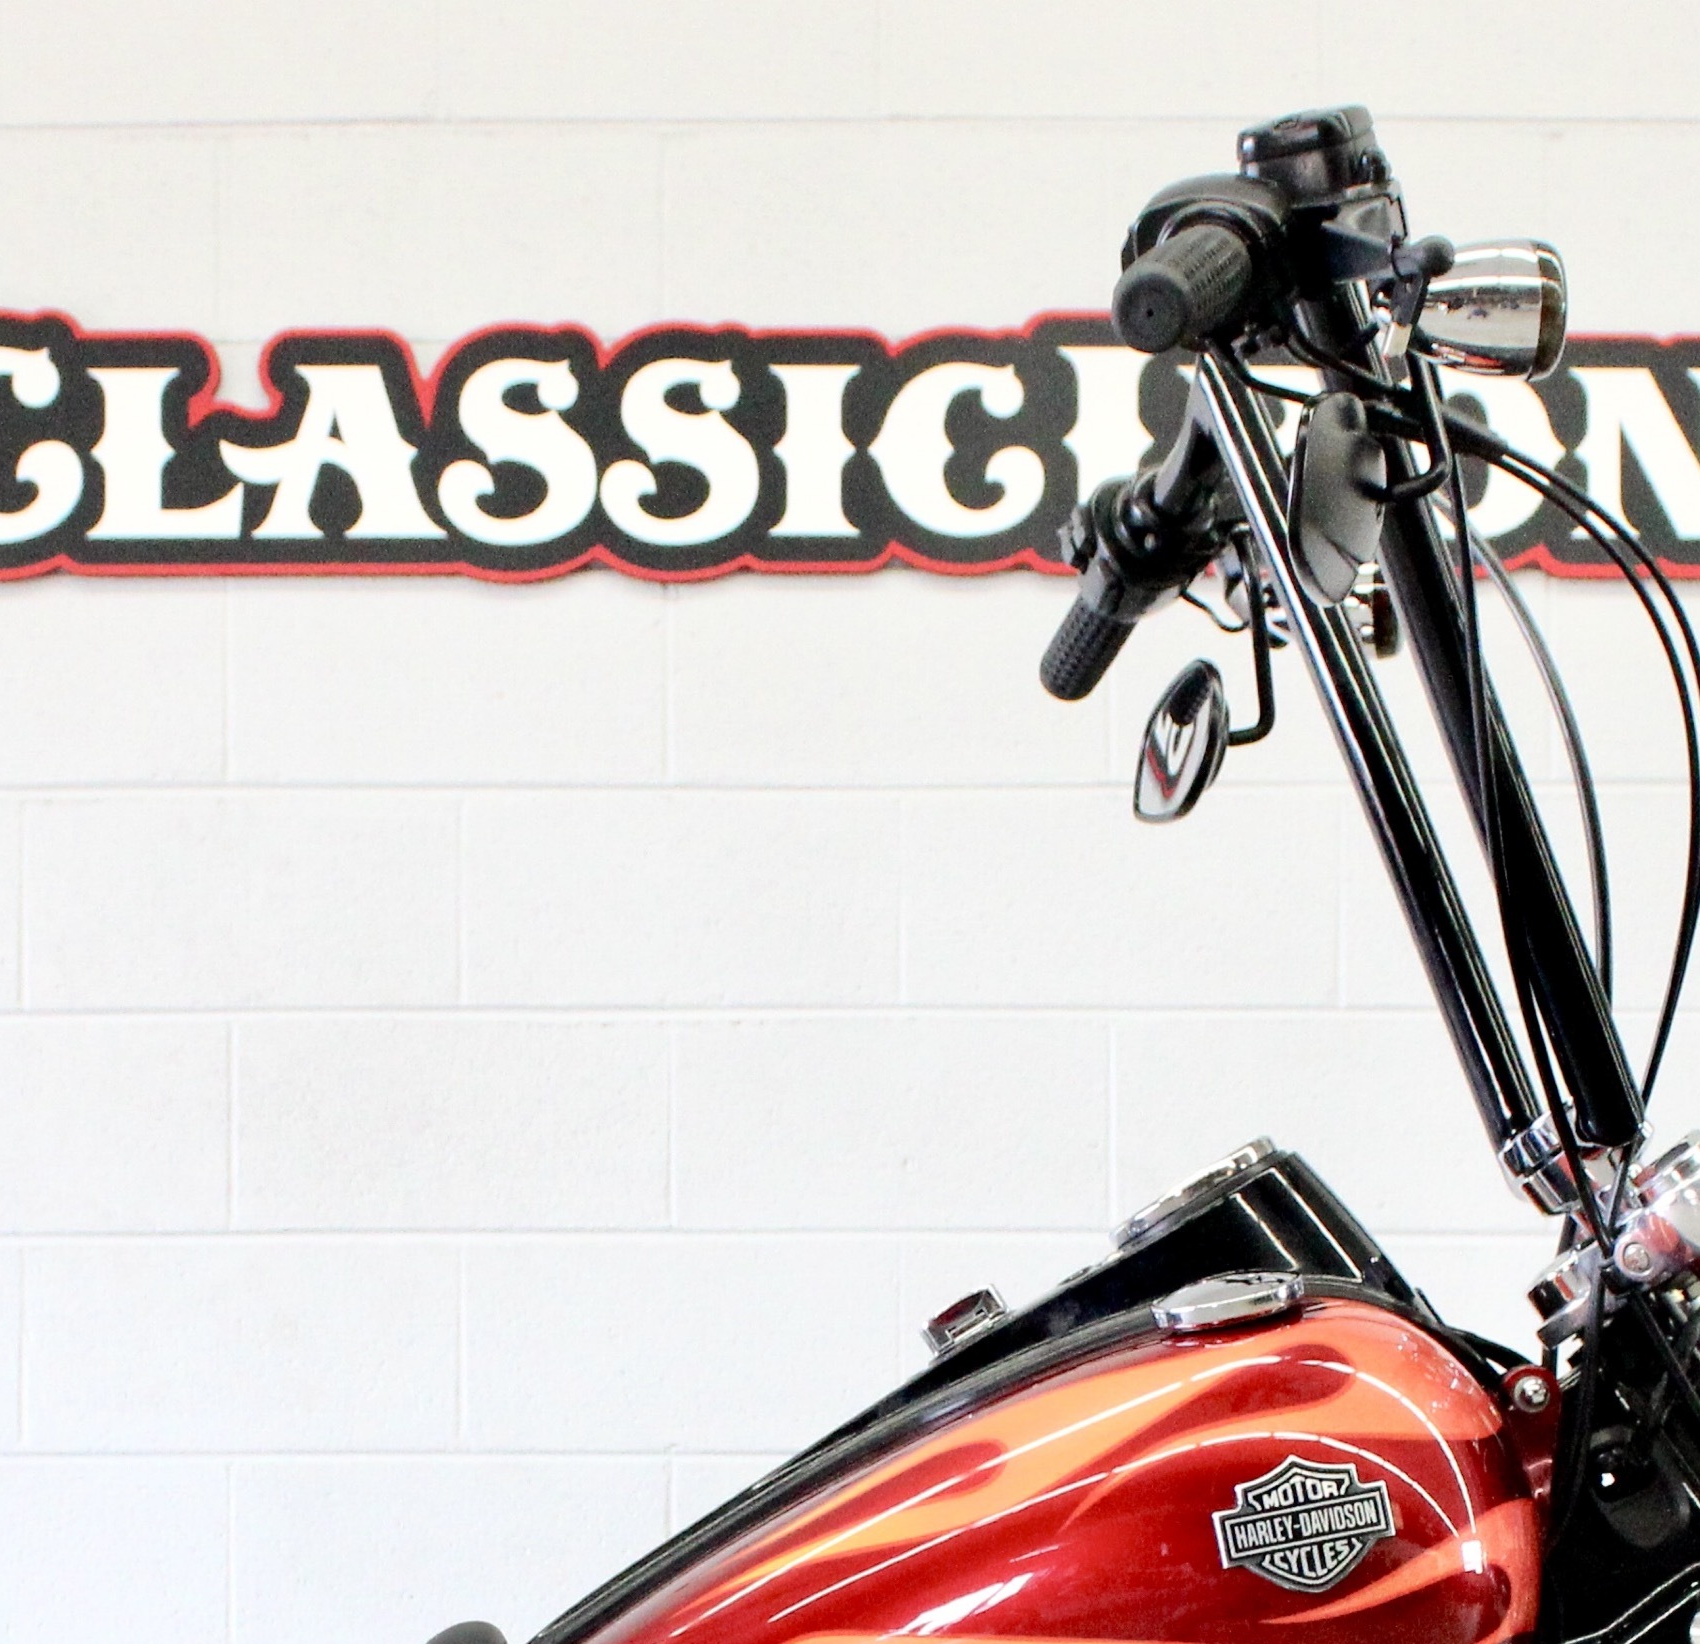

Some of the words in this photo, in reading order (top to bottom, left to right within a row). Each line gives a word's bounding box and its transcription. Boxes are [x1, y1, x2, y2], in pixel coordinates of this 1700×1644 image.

[1261, 1476, 1339, 1511] MOTOR
[1233, 1498, 1377, 1550] HARLEY-DAVIDSON
[1272, 1539, 1351, 1578] CYCLES
